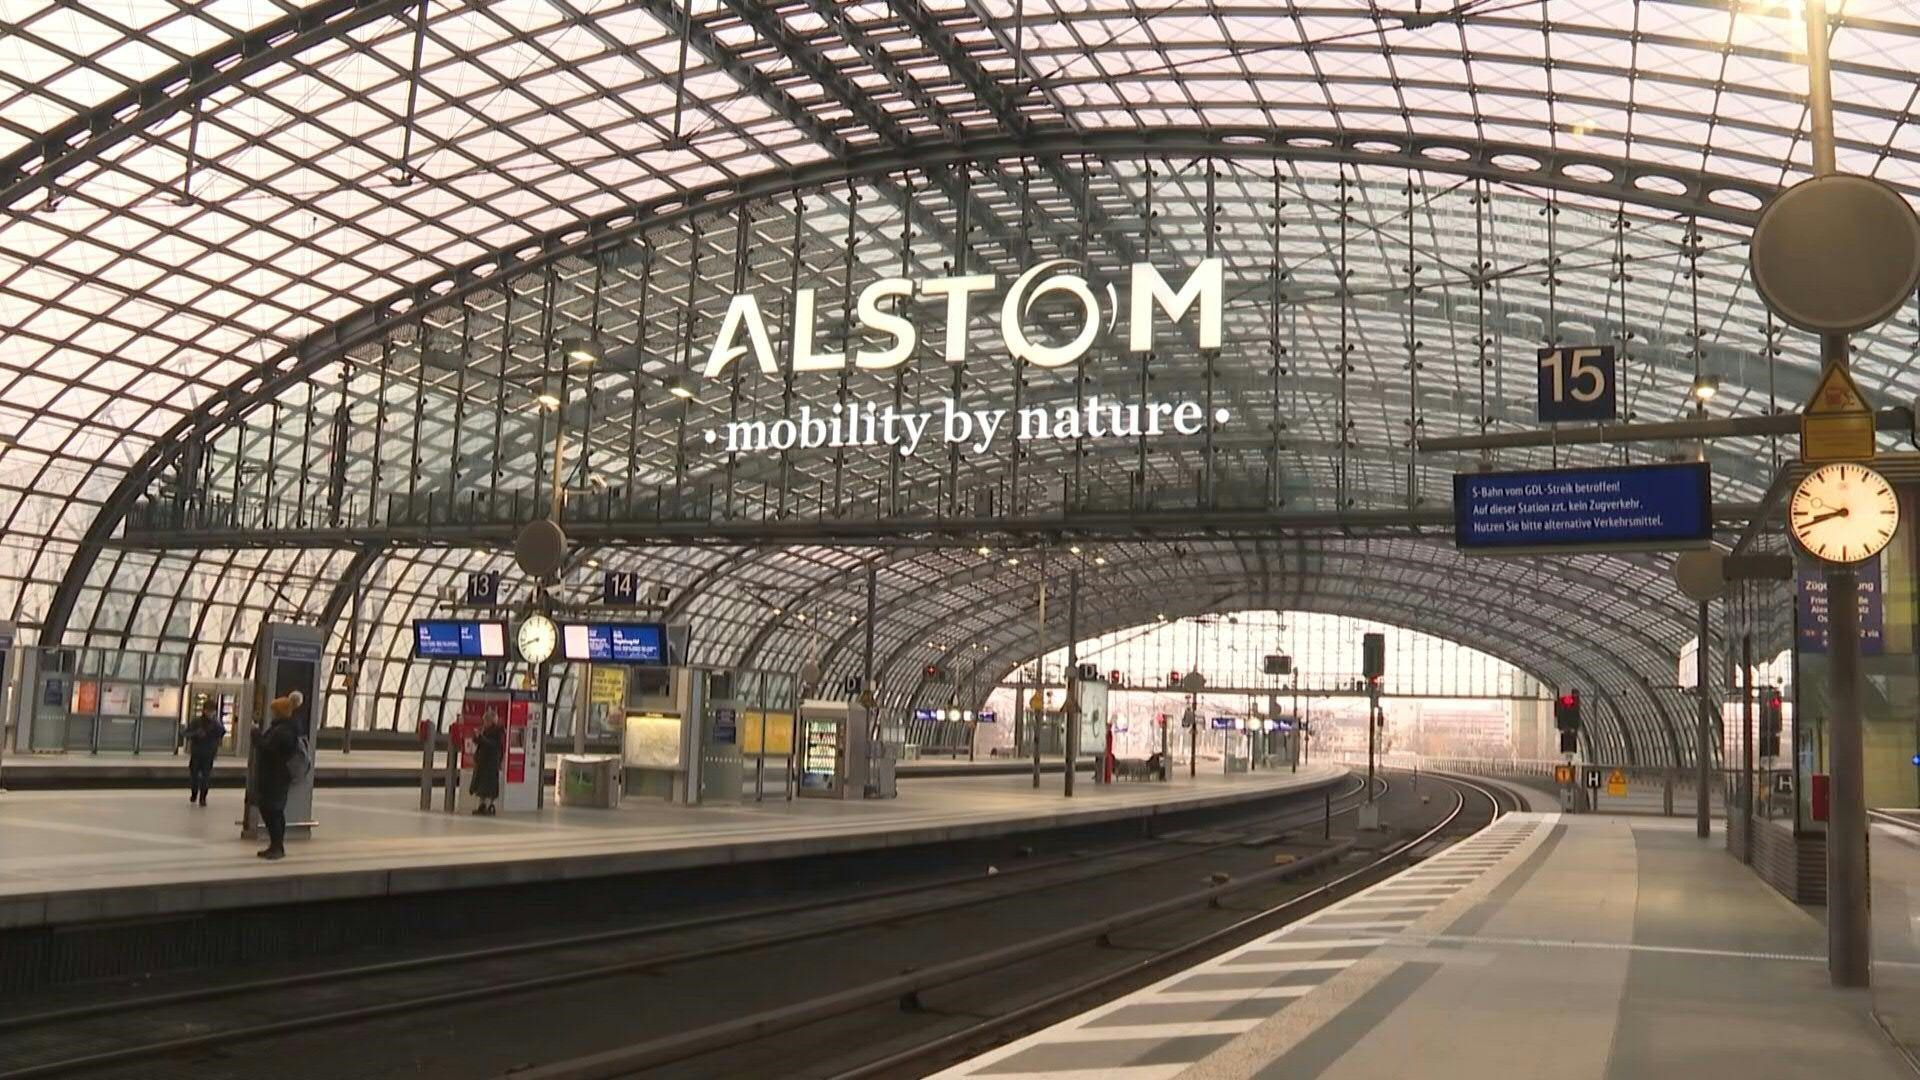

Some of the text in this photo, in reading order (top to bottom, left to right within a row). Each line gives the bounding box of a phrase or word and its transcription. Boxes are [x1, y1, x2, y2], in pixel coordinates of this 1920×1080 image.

[703, 257, 1223, 378] ALSTOM
[1540, 349, 1605, 402] 15
[725, 396, 1203, 456] mobility by nature
[1472, 481, 1620, 498] S-Bahn vom GDL-Streik betroffen!
[1473, 504, 1489, 515] Auf
[1490, 503, 1516, 515] dieser
[1518, 501, 1550, 514] Station
[1569, 500, 1588, 511] kein
[1589, 498, 1643, 513] Zugverkehr.
[1474, 514, 1663, 532] Nutzen Sie bitte alternative Verkehrsmittel.
[470, 575, 489, 597] 13
[612, 574, 632, 597] 14
[1588, 771, 1599, 787] H
